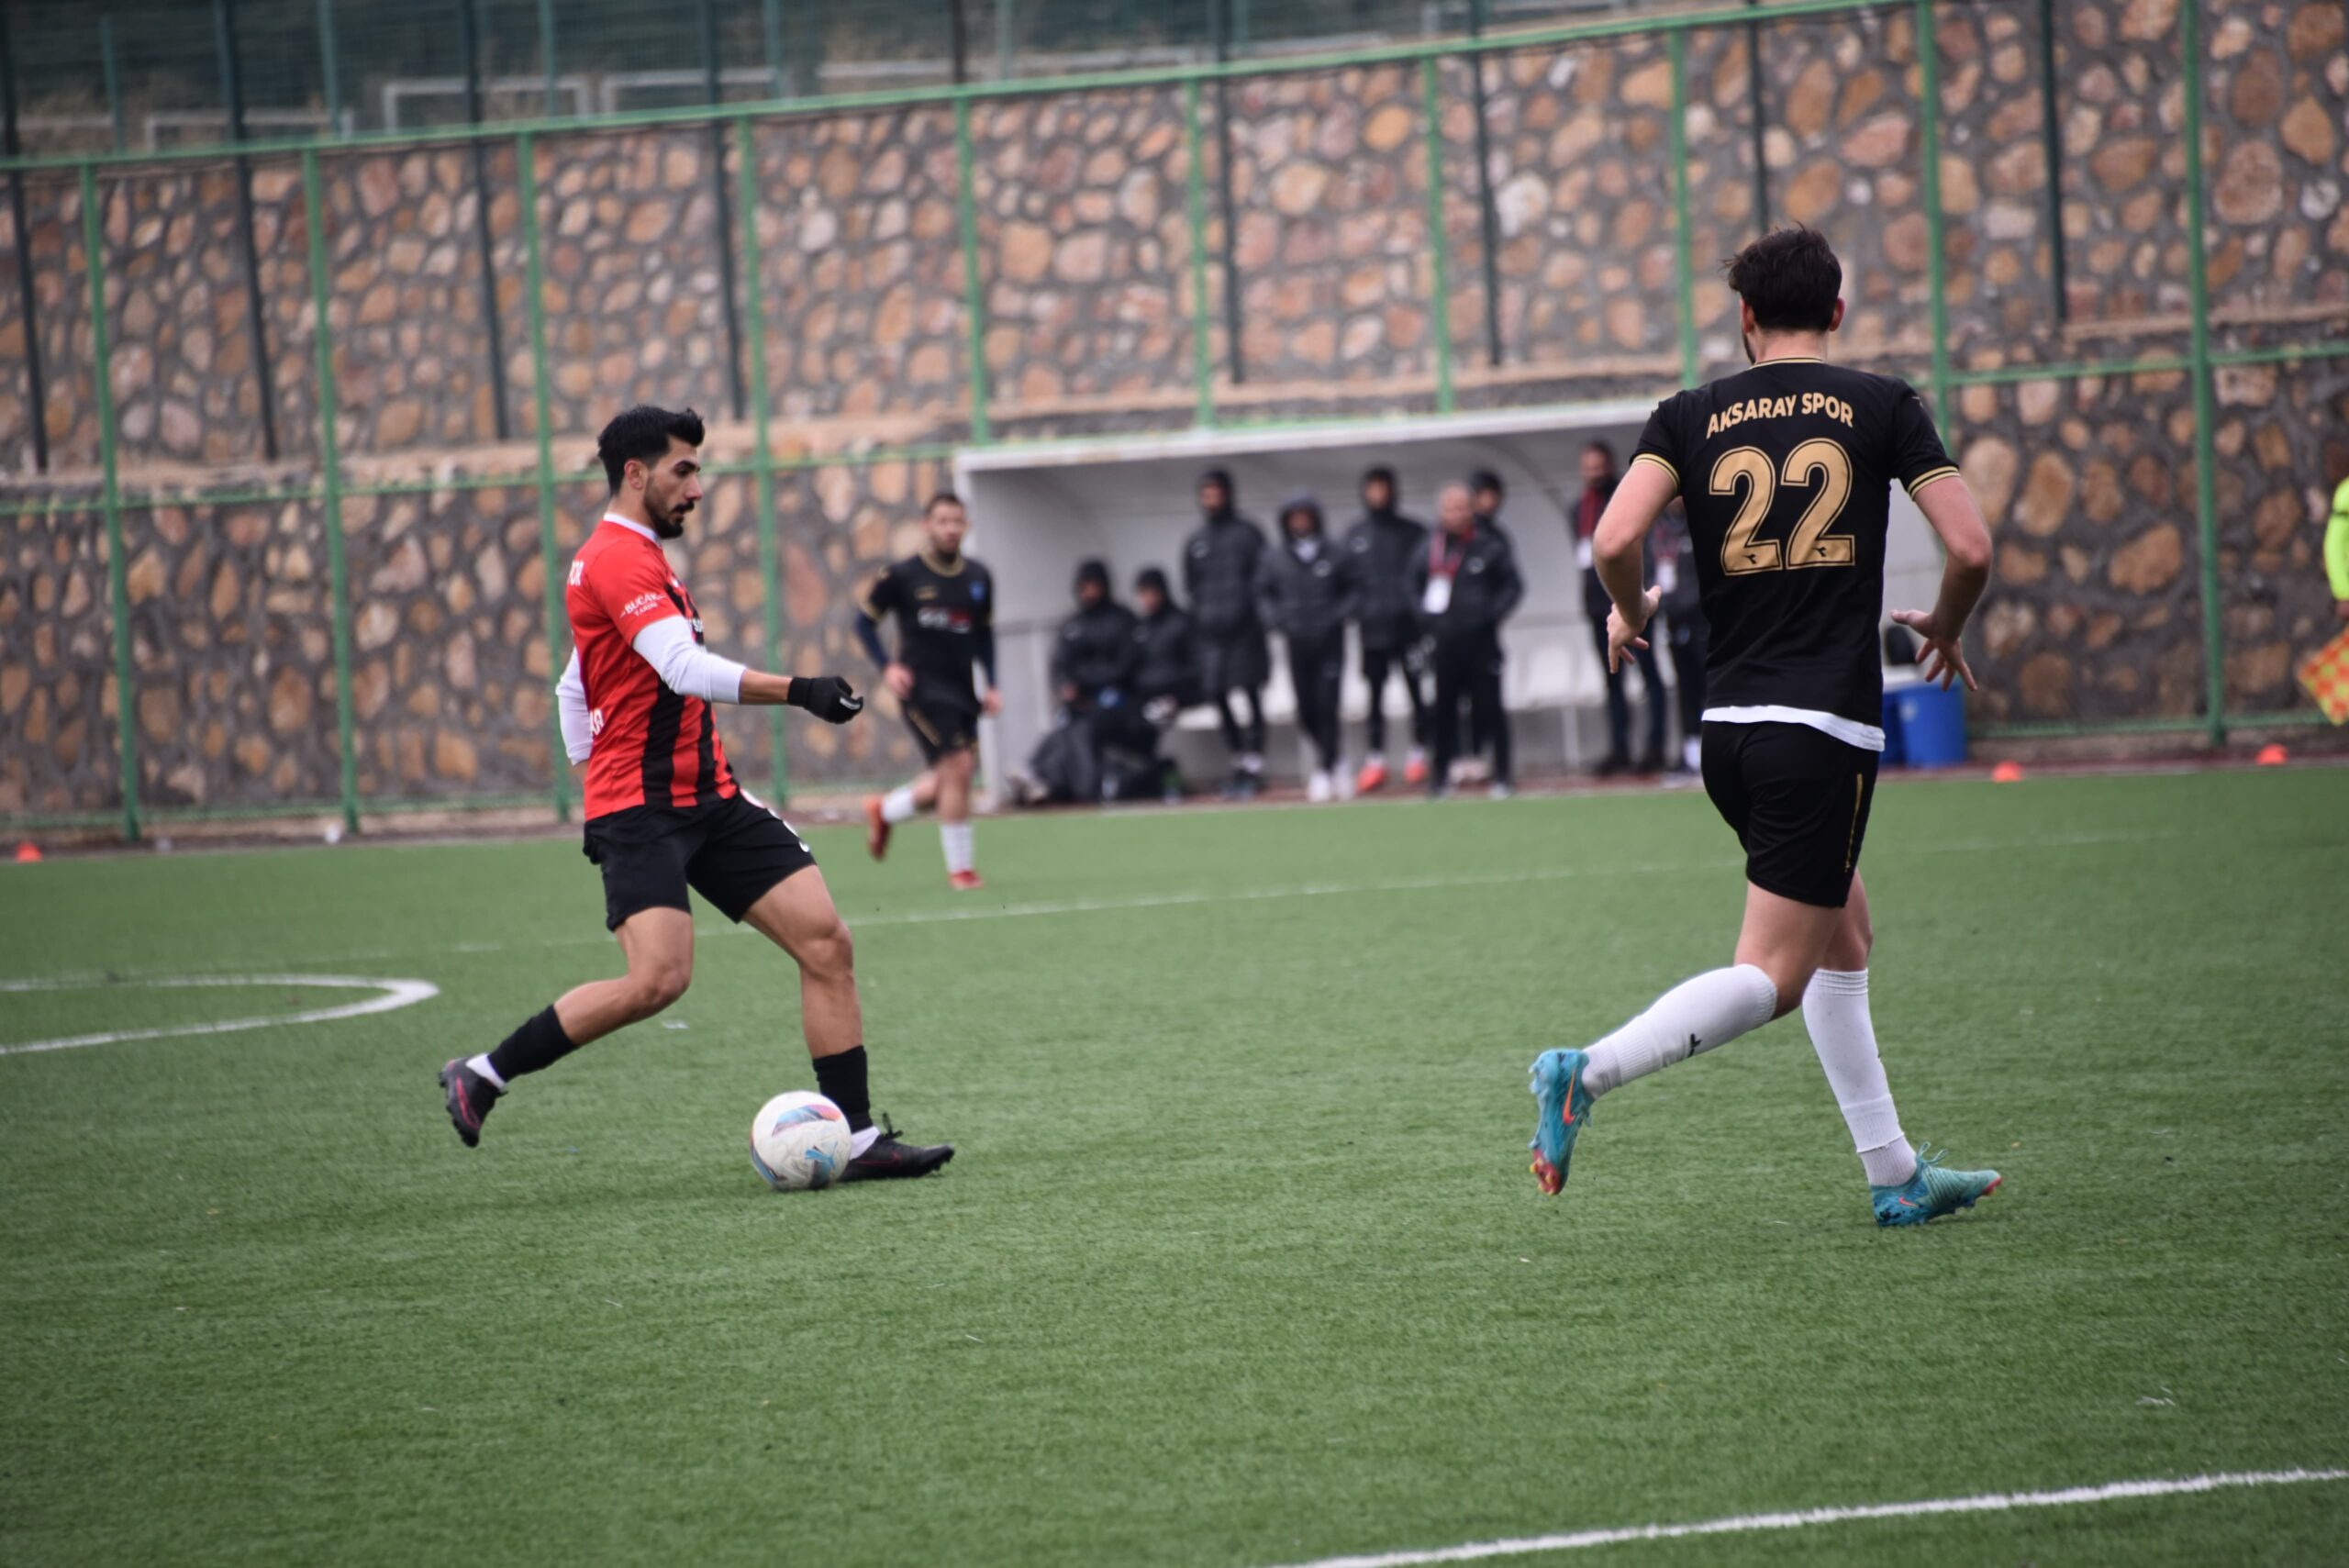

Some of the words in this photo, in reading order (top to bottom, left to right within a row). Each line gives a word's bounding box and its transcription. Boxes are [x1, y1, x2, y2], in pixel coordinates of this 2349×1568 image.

[1706, 395, 1797, 439] AKSARAY
[1801, 392, 1854, 428] SPOR
[1709, 437, 1855, 576] 22
